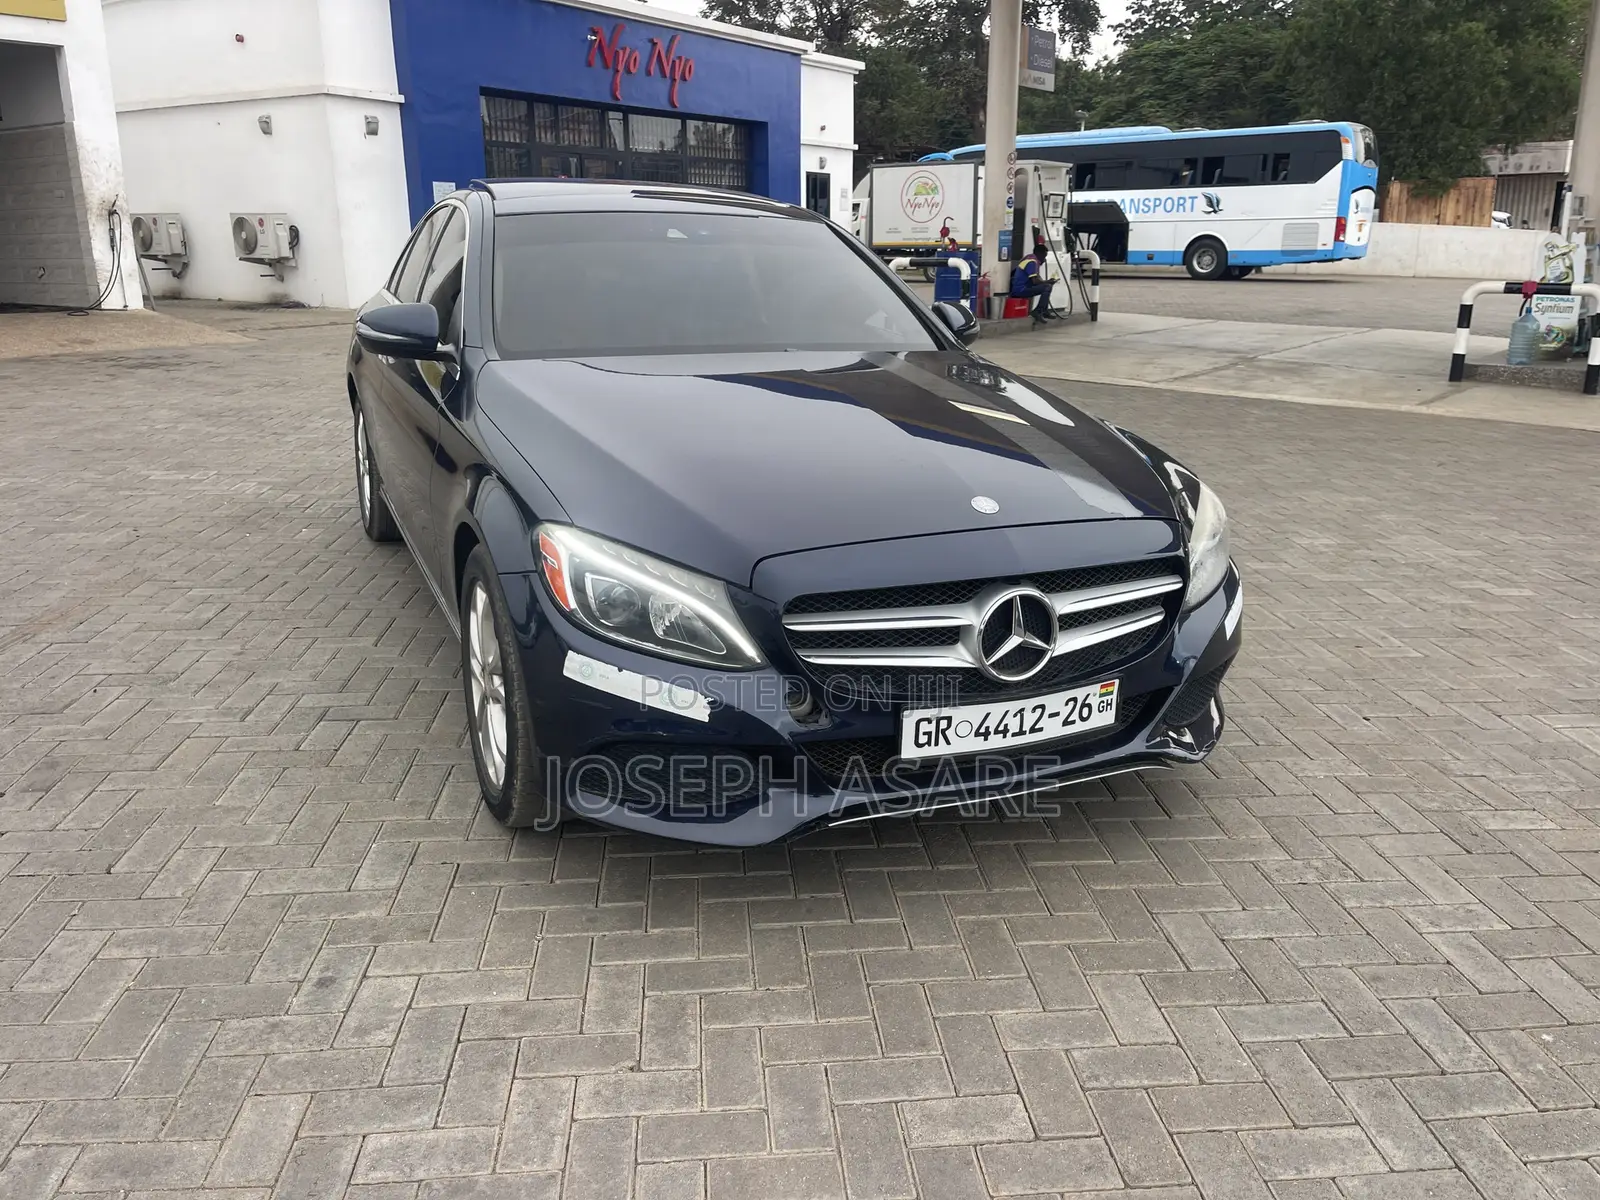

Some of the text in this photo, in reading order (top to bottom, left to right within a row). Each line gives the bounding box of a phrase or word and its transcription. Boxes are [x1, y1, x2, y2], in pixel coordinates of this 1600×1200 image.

[587, 23, 695, 108] Nyo Nyo
[1097, 196, 1198, 214] ANSPORT
[1534, 302, 1574, 315] Syntium
[1098, 698, 1113, 713] GH
[913, 692, 1094, 749] GR 4412-26
